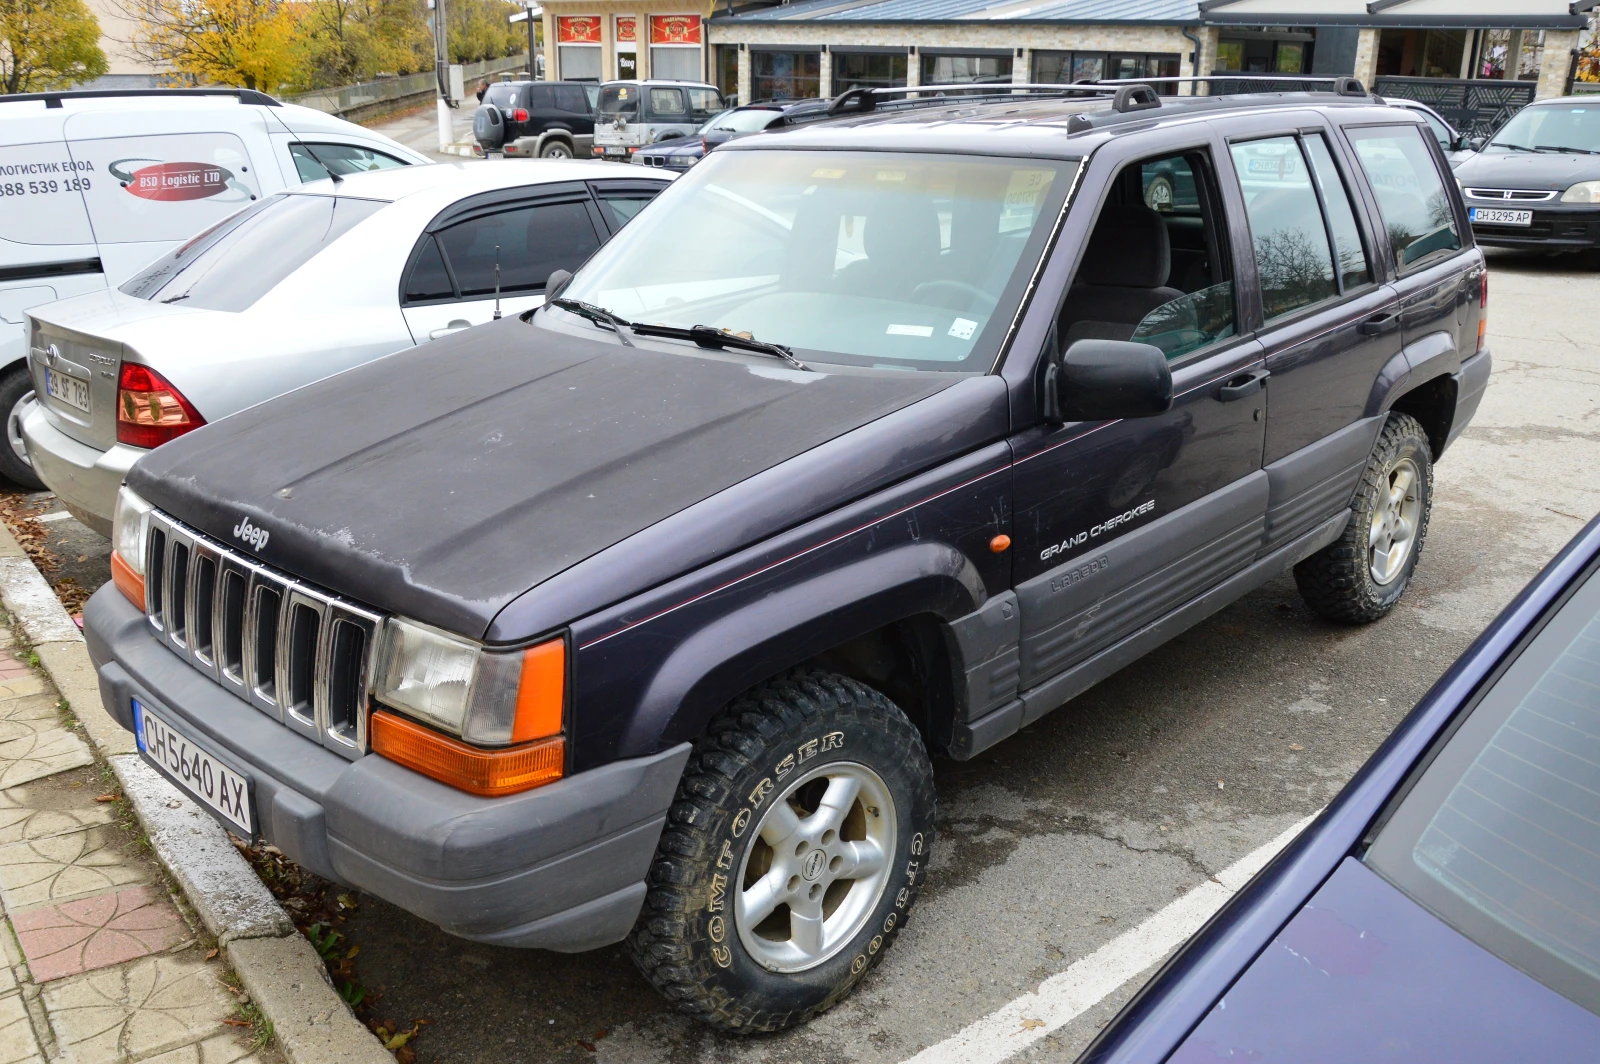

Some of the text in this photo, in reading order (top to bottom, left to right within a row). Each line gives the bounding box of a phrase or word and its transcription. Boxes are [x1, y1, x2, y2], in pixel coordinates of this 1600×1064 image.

[62, 160, 95, 173] ЕООД
[140, 171, 220, 188] BSD Logistic LTD
[28, 180, 58, 195] 539
[63, 178, 91, 192] 189
[1515, 212, 1530, 223] AP
[61, 376, 69, 399] SF
[233, 516, 270, 552] Jeep
[1040, 499, 1155, 561] GRAND CHEROKEE
[1051, 555, 1109, 593] LAREDO
[220, 771, 246, 825] AX
[707, 730, 846, 968] COMFORSER
[851, 832, 924, 975] CF3000
